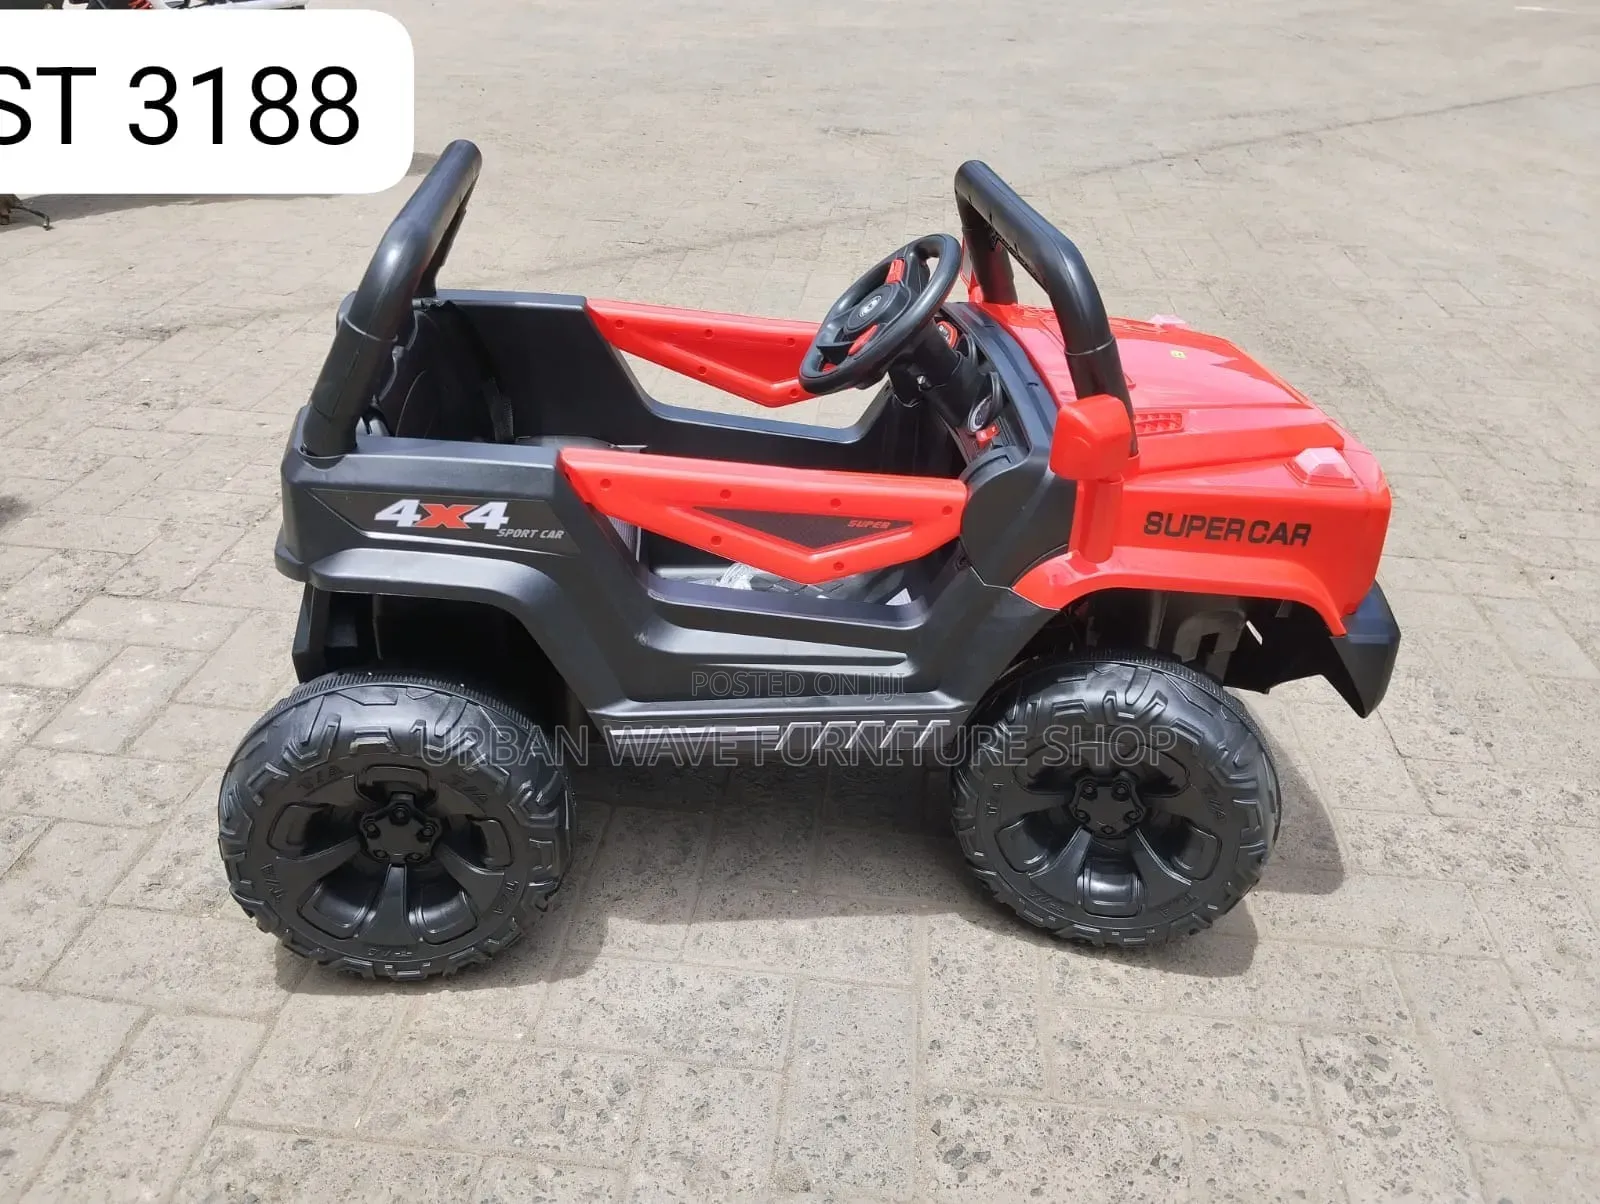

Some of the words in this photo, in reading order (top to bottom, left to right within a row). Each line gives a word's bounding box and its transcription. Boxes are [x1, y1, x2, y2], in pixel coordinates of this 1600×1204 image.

[848, 519, 891, 529] SUPER
[497, 528, 537, 540] SPORT
[540, 530, 565, 540] CAR
